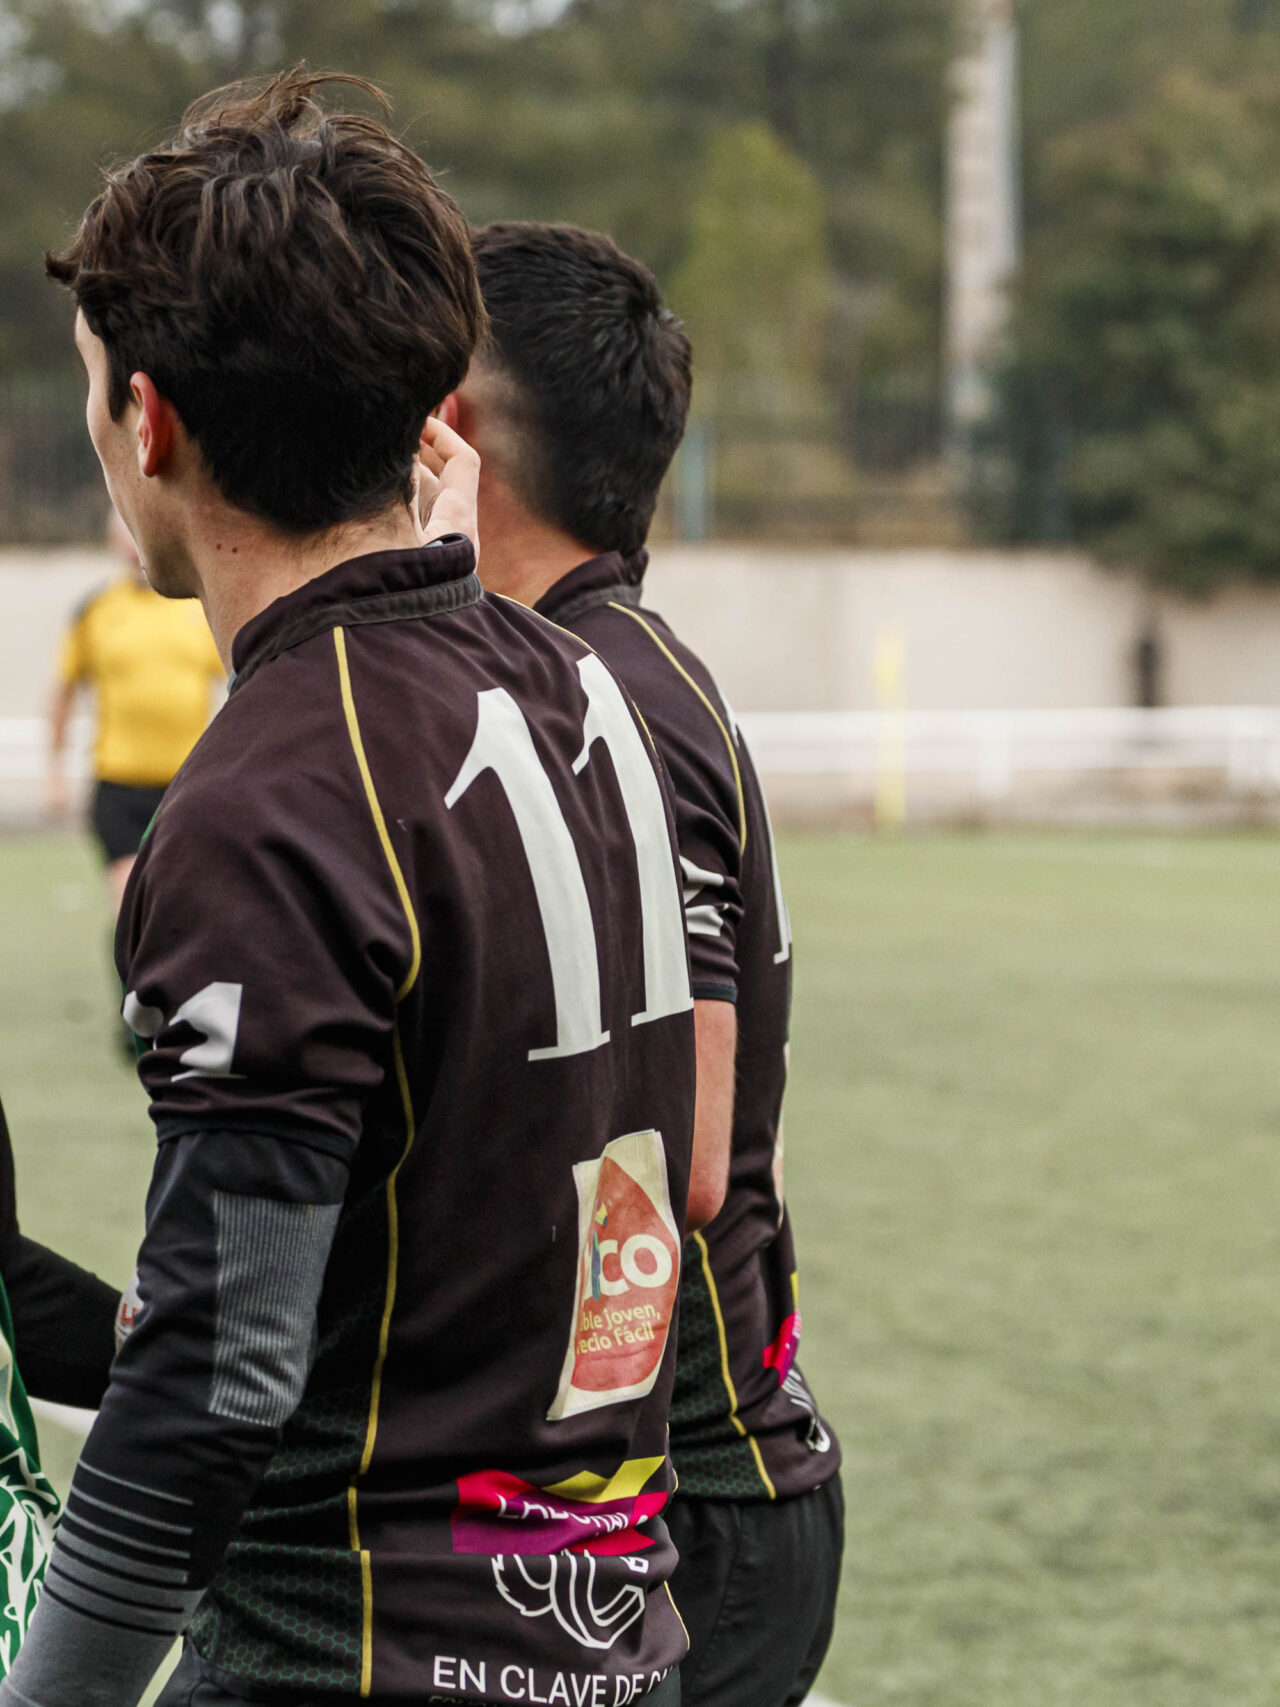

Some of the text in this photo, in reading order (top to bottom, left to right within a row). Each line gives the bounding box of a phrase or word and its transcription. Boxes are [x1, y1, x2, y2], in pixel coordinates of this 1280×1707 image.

[443, 652, 695, 1061] 11
[580, 1310, 603, 1331] ble
[433, 1655, 486, 1694] EN
[500, 1664, 607, 1707] CLAVE
